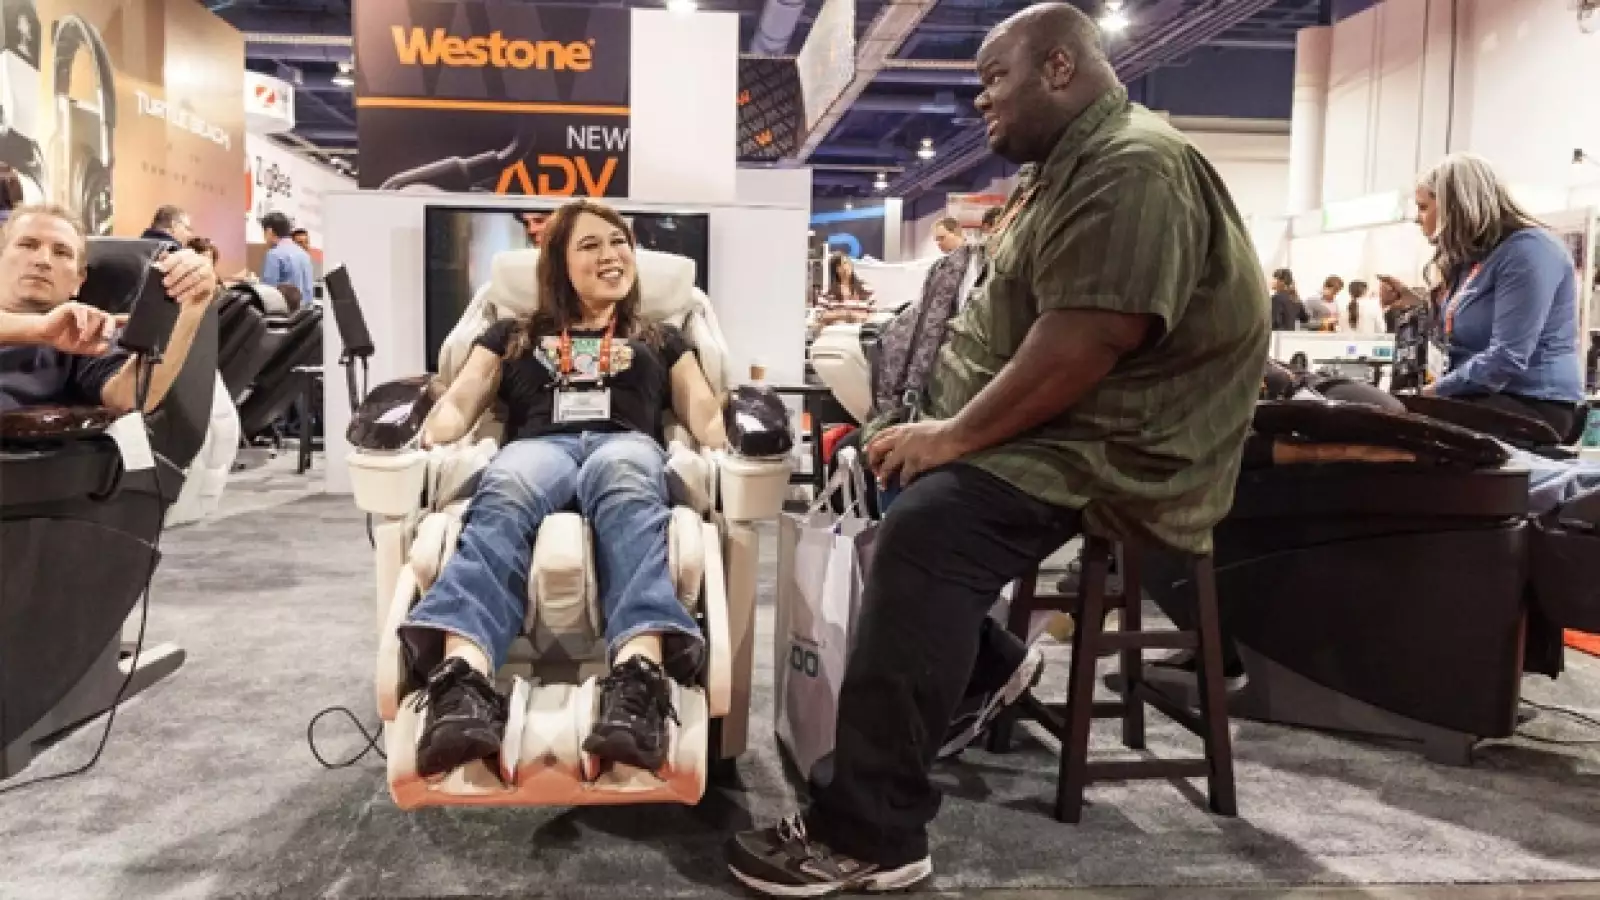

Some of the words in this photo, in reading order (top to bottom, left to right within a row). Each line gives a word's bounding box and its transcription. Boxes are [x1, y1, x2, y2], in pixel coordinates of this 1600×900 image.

[391, 25, 593, 71] Westone
[566, 125, 630, 151] NEW
[496, 154, 618, 197] ADV
